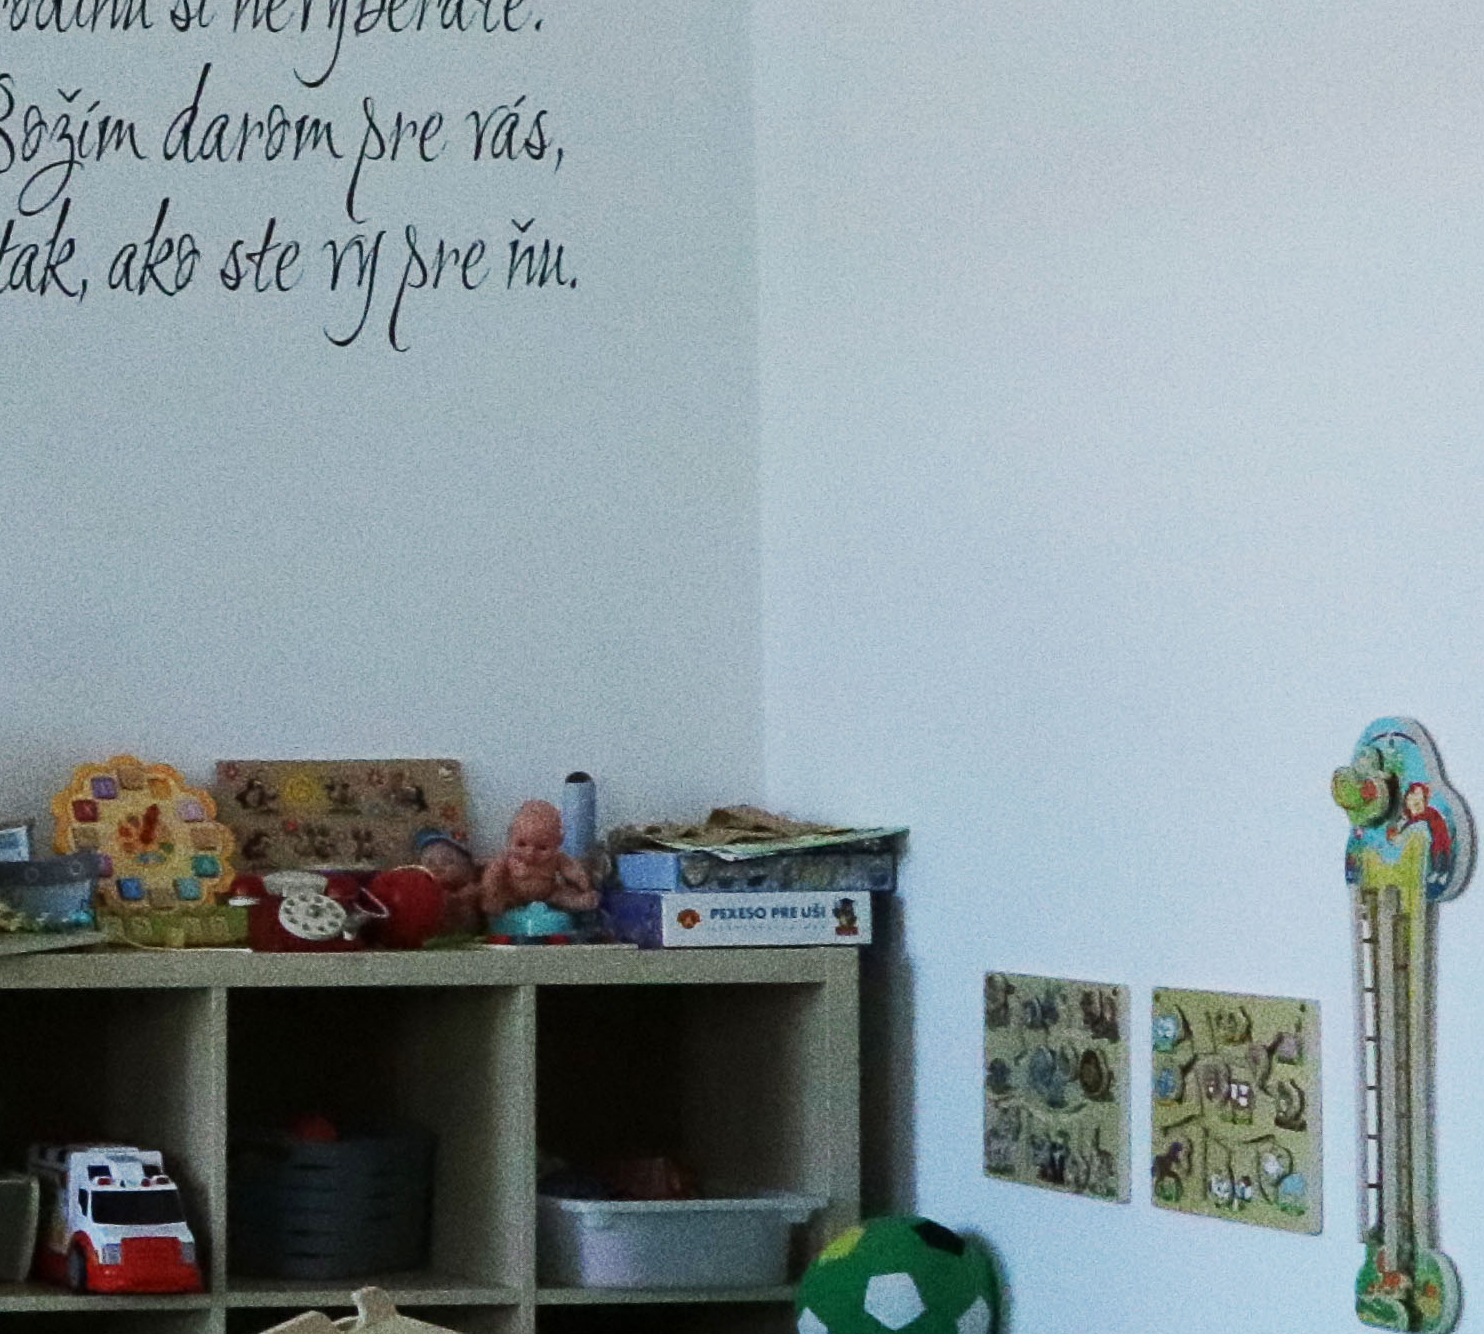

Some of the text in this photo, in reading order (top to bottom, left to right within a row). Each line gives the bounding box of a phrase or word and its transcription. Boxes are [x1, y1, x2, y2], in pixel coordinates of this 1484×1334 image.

[162, 62, 344, 164] darom
[345, 96, 444, 225] pre
[465, 94, 564, 172] vás,
[107, 196, 201, 298] ako
[219, 217, 301, 293] ste
[321, 229, 386, 348] vy
[387, 224, 488, 353] pre
[506, 218, 578, 290] ňu.
[710, 904, 826, 919] PEXESO PRE UŠI
